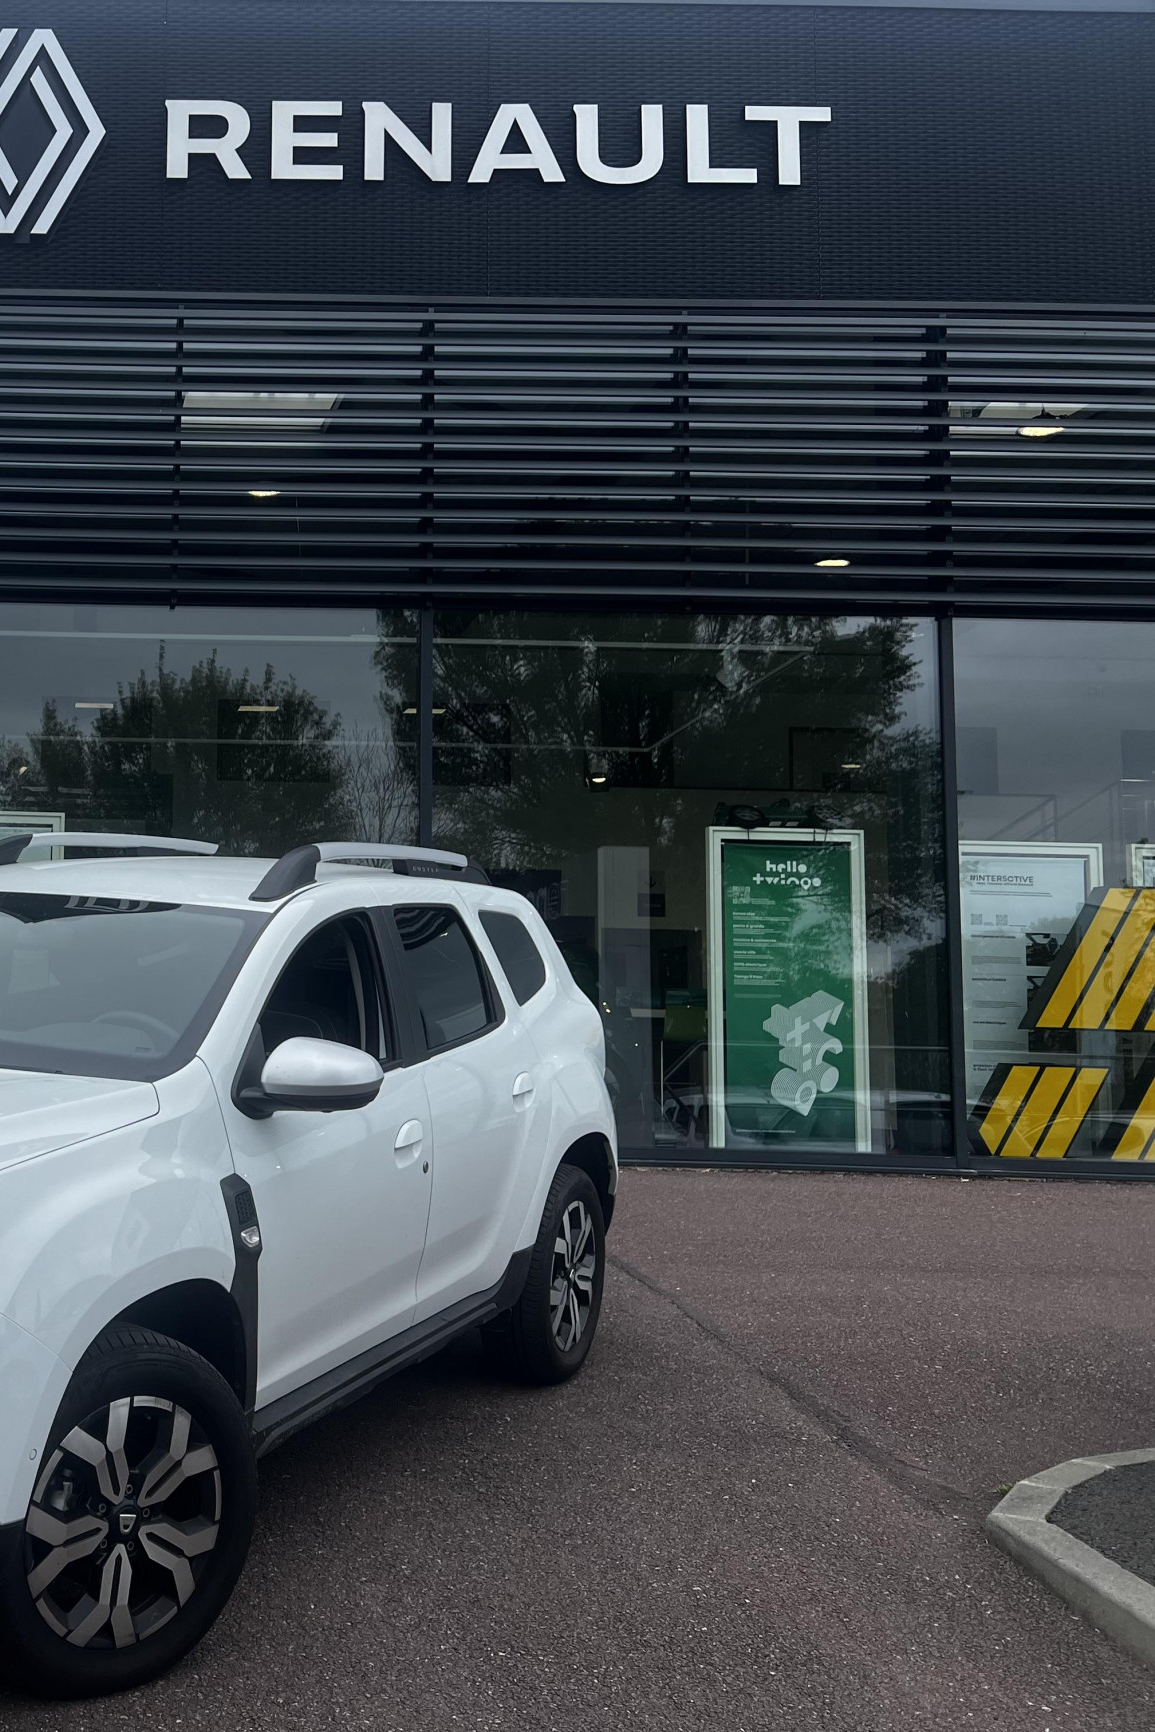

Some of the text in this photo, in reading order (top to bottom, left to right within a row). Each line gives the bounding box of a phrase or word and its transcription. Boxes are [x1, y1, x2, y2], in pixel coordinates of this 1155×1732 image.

[164, 99, 832, 185] RENAULT
[765, 860, 807, 873] hello
[752, 873, 822, 890] twingo
